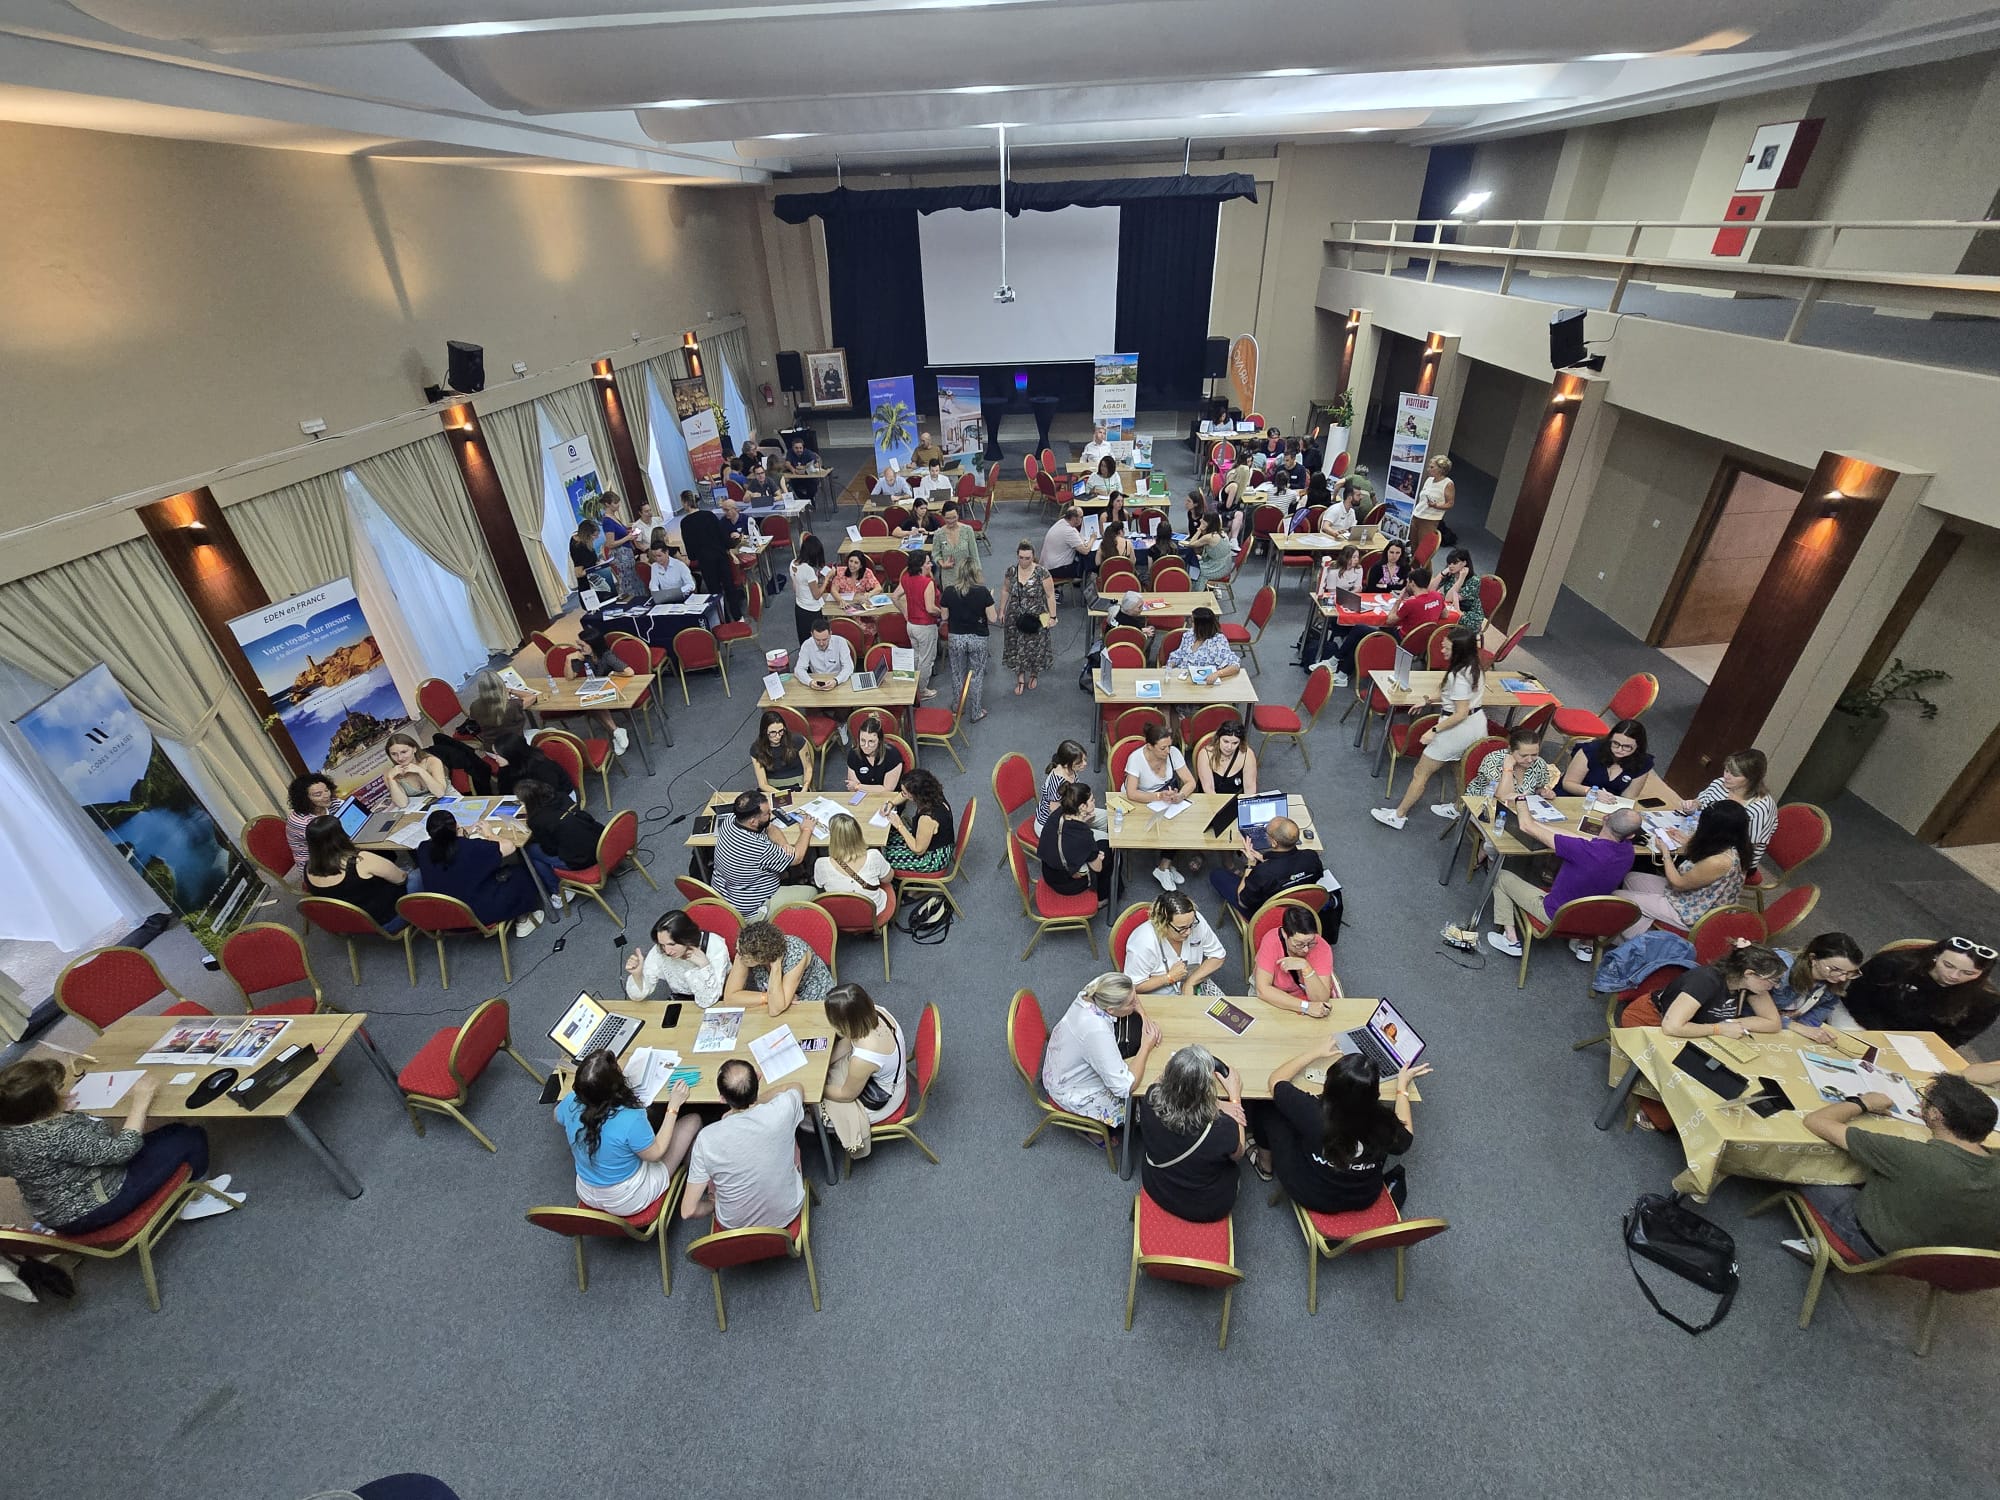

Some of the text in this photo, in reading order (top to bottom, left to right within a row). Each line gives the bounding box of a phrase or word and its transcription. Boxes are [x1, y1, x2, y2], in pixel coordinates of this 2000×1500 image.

[263, 610, 285, 624] EDEN
[286, 606, 296, 614] en
[296, 592, 326, 610] FRANCE
[262, 613, 352, 656] Votre voyage sur mesure
